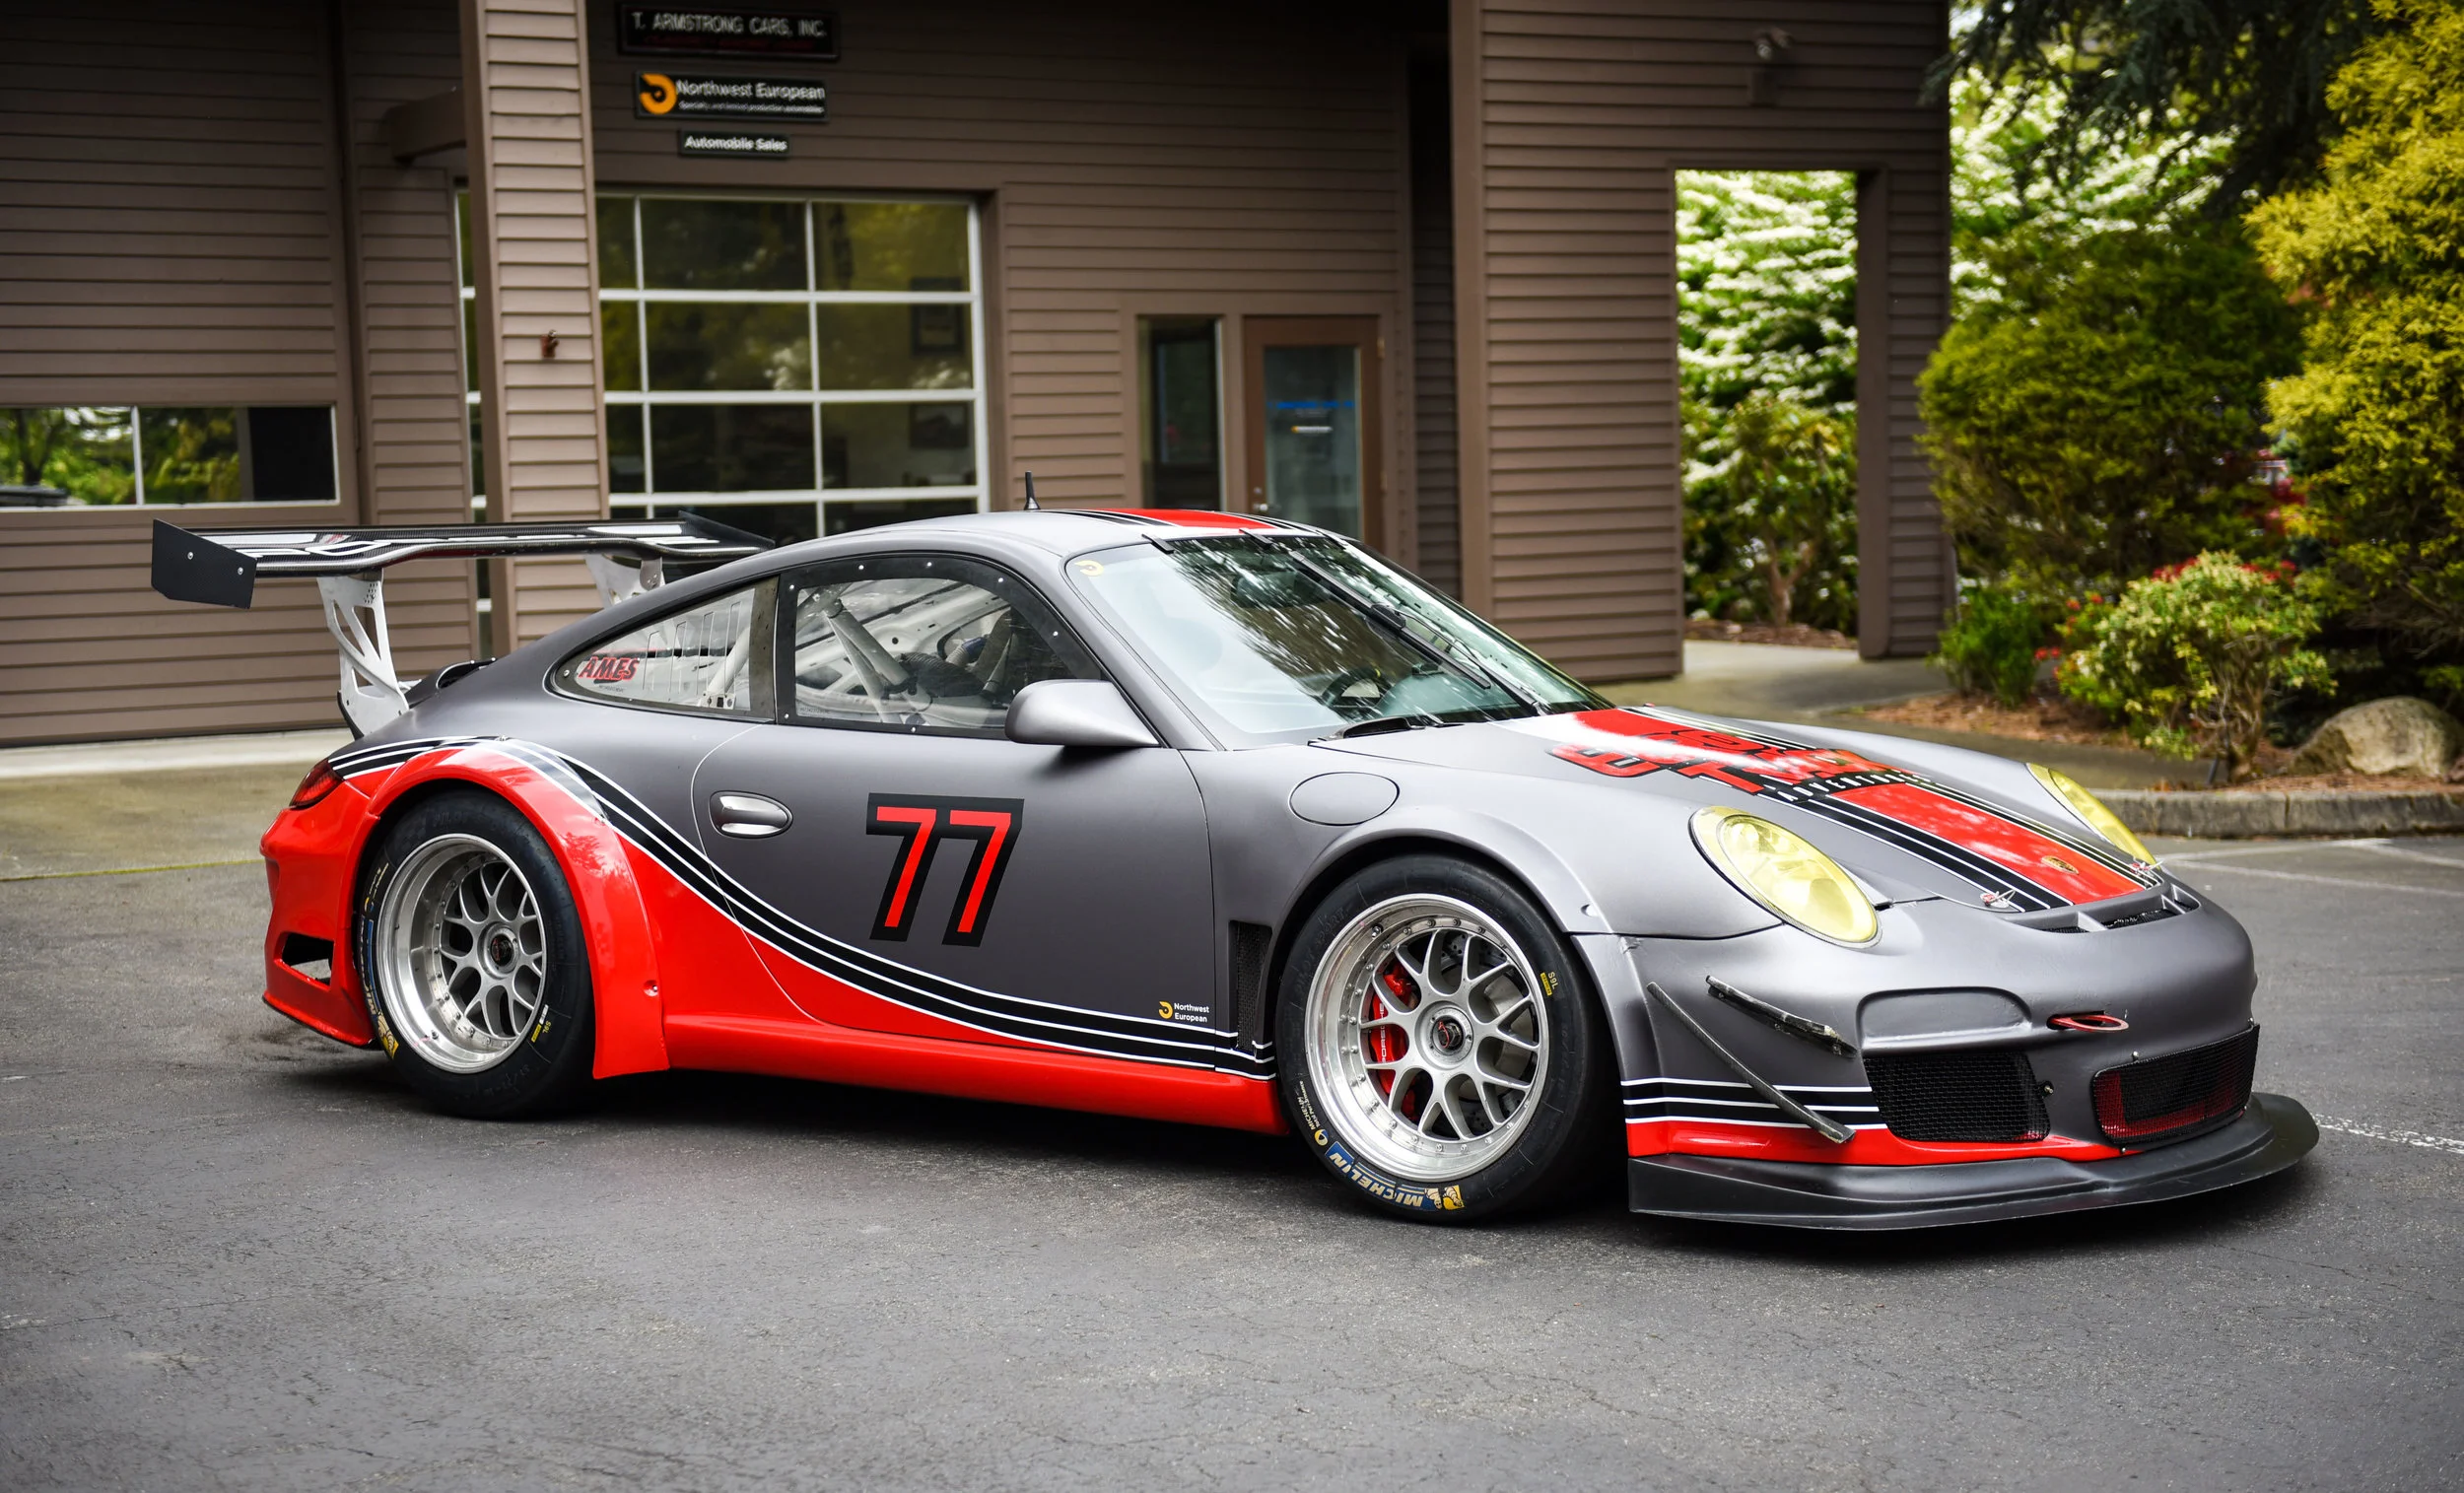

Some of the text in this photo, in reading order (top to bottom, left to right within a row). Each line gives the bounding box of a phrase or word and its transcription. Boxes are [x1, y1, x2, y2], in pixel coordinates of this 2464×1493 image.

[632, 12, 647, 30] T.
[652, 13, 744, 34] ARMSTRONG
[797, 20, 827, 36] INC.
[675, 79, 825, 102] Northwest European
[684, 136, 787, 151] Automobile Sales
[579, 656, 641, 682] AMES
[870, 798, 1020, 942] 77
[1548, 972, 1558, 989] S9L
[1174, 1002, 1209, 1023] Northwest European
[1329, 1152, 1424, 1207] MICHELIN
